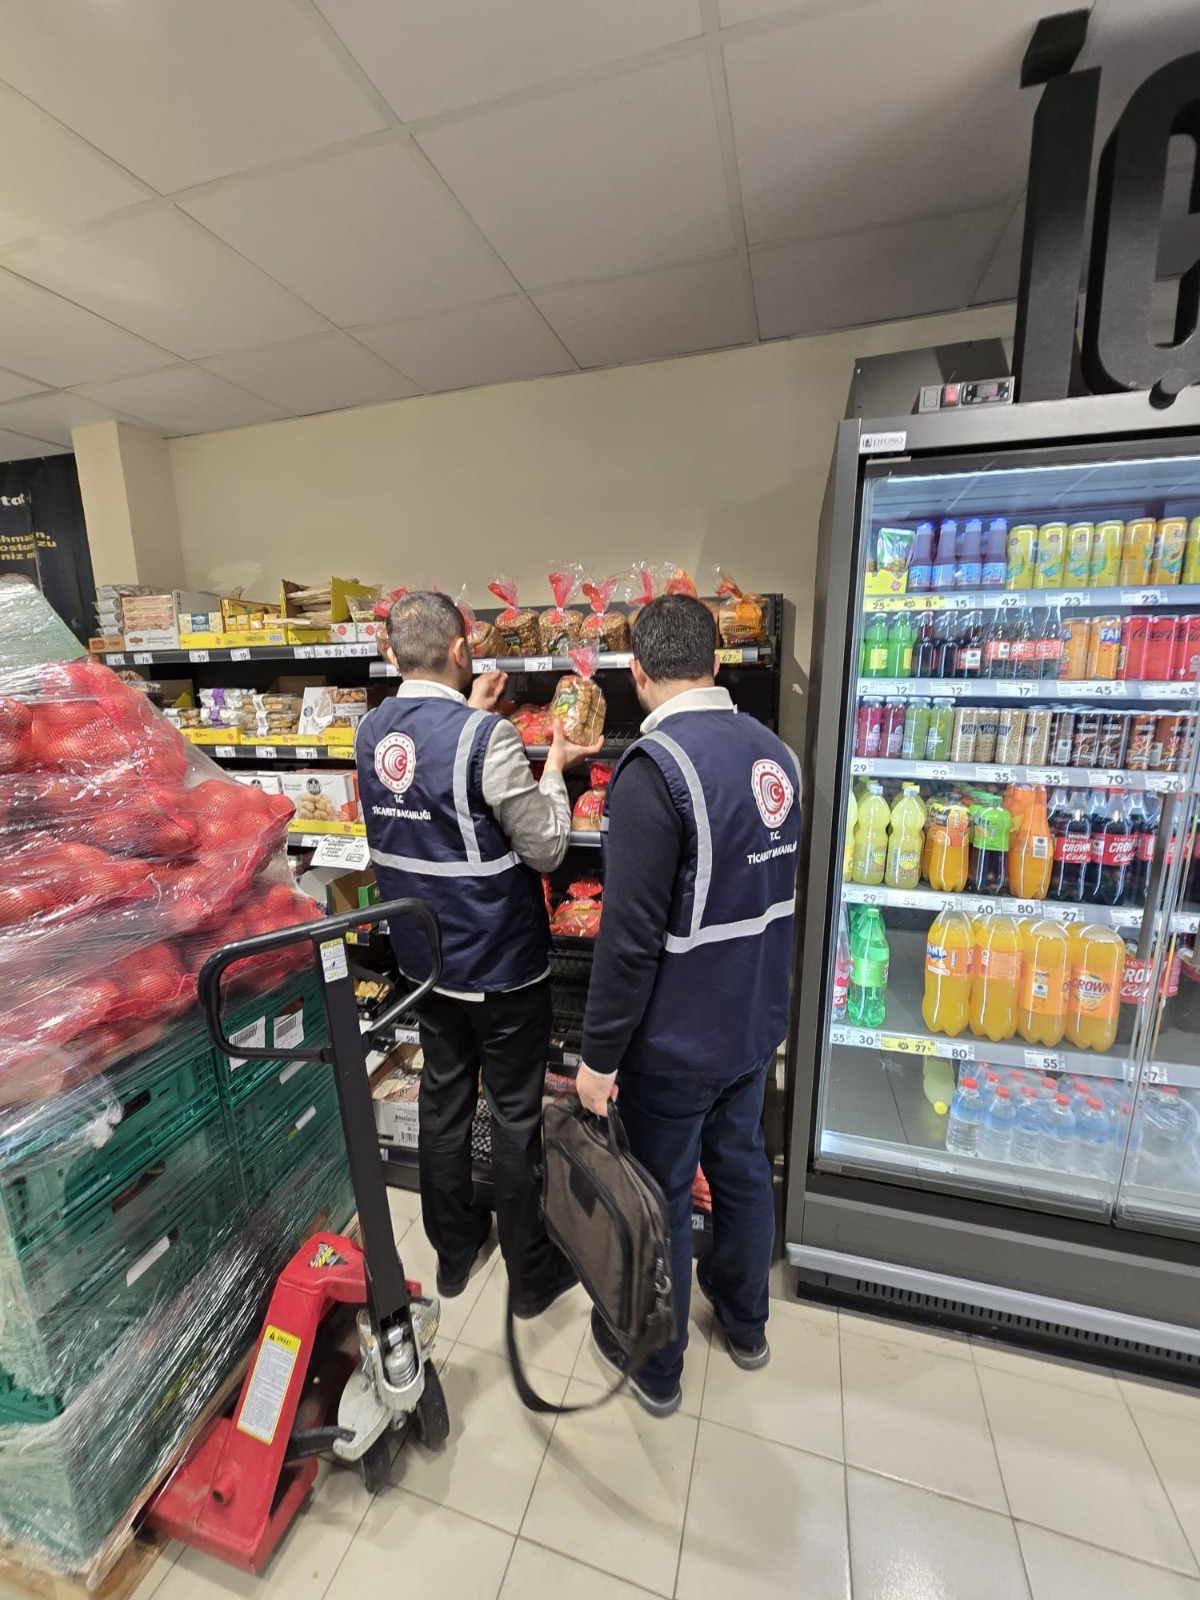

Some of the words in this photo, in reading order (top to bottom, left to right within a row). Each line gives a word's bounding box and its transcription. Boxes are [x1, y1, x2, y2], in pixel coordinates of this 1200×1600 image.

[955, 598, 968, 608] 15
[1001, 598, 1018, 607] 42
[1065, 597, 1081, 606] 23
[1141, 595, 1158, 604] 23
[872, 602, 885, 610] 25
[722, 653, 733, 662] 67
[481, 662, 491, 671] 75
[537, 661, 547, 670] 72
[896, 685, 907, 694] 12
[951, 686, 963, 695] 12
[1019, 686, 1031, 695] 17
[1095, 685, 1112, 695] 45
[1180, 687, 1196, 697] 45
[853, 764, 867, 773] 29
[994, 772, 1010, 782] 35
[1045, 774, 1061, 785] 35
[1106, 775, 1124, 785] 70
[372, 805, 396, 817] TİCARET
[769, 830, 781, 841] T.C.
[1062, 843, 1091, 853] CROWN
[863, 893, 877, 904] 29
[941, 901, 954, 911] 75
[977, 905, 994, 915] 60
[1017, 904, 1034, 915] 80
[1062, 911, 1077, 921] 27
[1073, 977, 1113, 993] CROWN
[832, 1032, 845, 1043] 55
[859, 1035, 874, 1045] 30
[915, 1044, 926, 1053] 27
[951, 1048, 967, 1059] 80
[1043, 1057, 1058, 1069] 55
